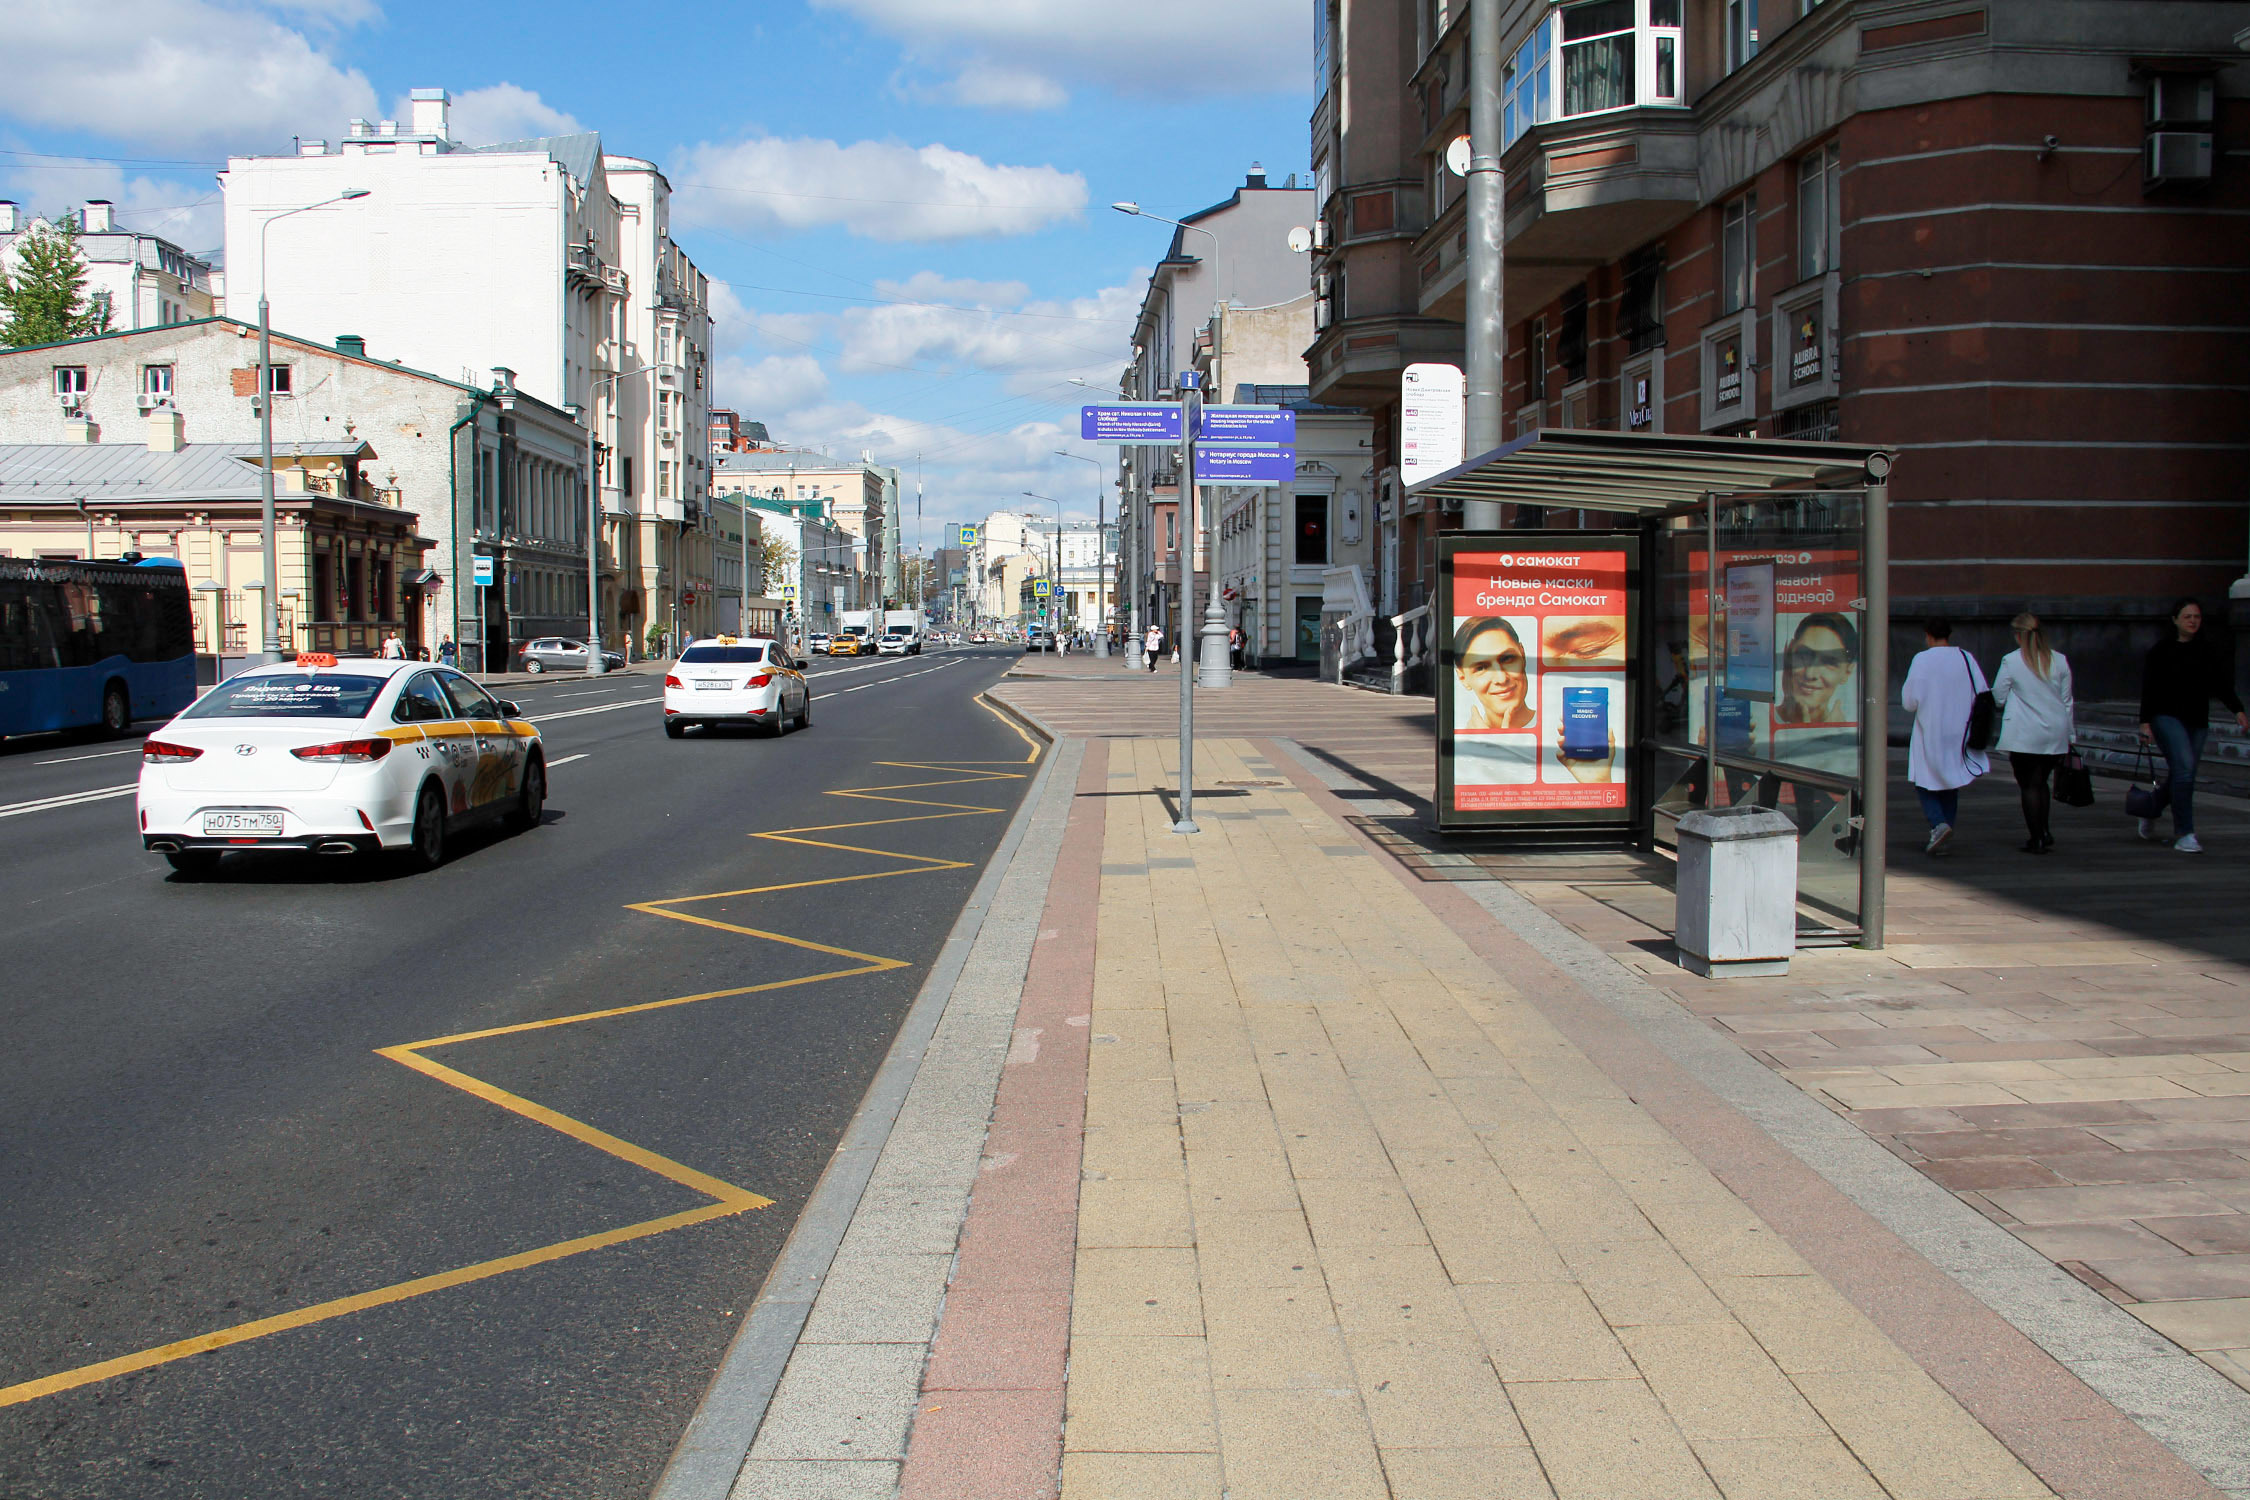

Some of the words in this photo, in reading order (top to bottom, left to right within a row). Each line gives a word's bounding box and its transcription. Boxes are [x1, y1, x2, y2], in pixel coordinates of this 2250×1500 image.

[1793, 345, 1819, 366] ALIBRA
[1793, 362, 1821, 381] SCHOOL
[1719, 372, 1740, 389] ALIBRA
[1719, 387, 1741, 402] SCHOOL
[1516, 556, 1581, 566] самокат
[1490, 575, 1541, 589] Новые
[1546, 579, 1594, 589] маски
[1476, 592, 1535, 609] бренда
[1539, 592, 1608, 606] Самокат
[1606, 792, 1617, 803] 6+
[209, 816, 258, 828] Н075ТМ
[260, 815, 279, 824] 750
